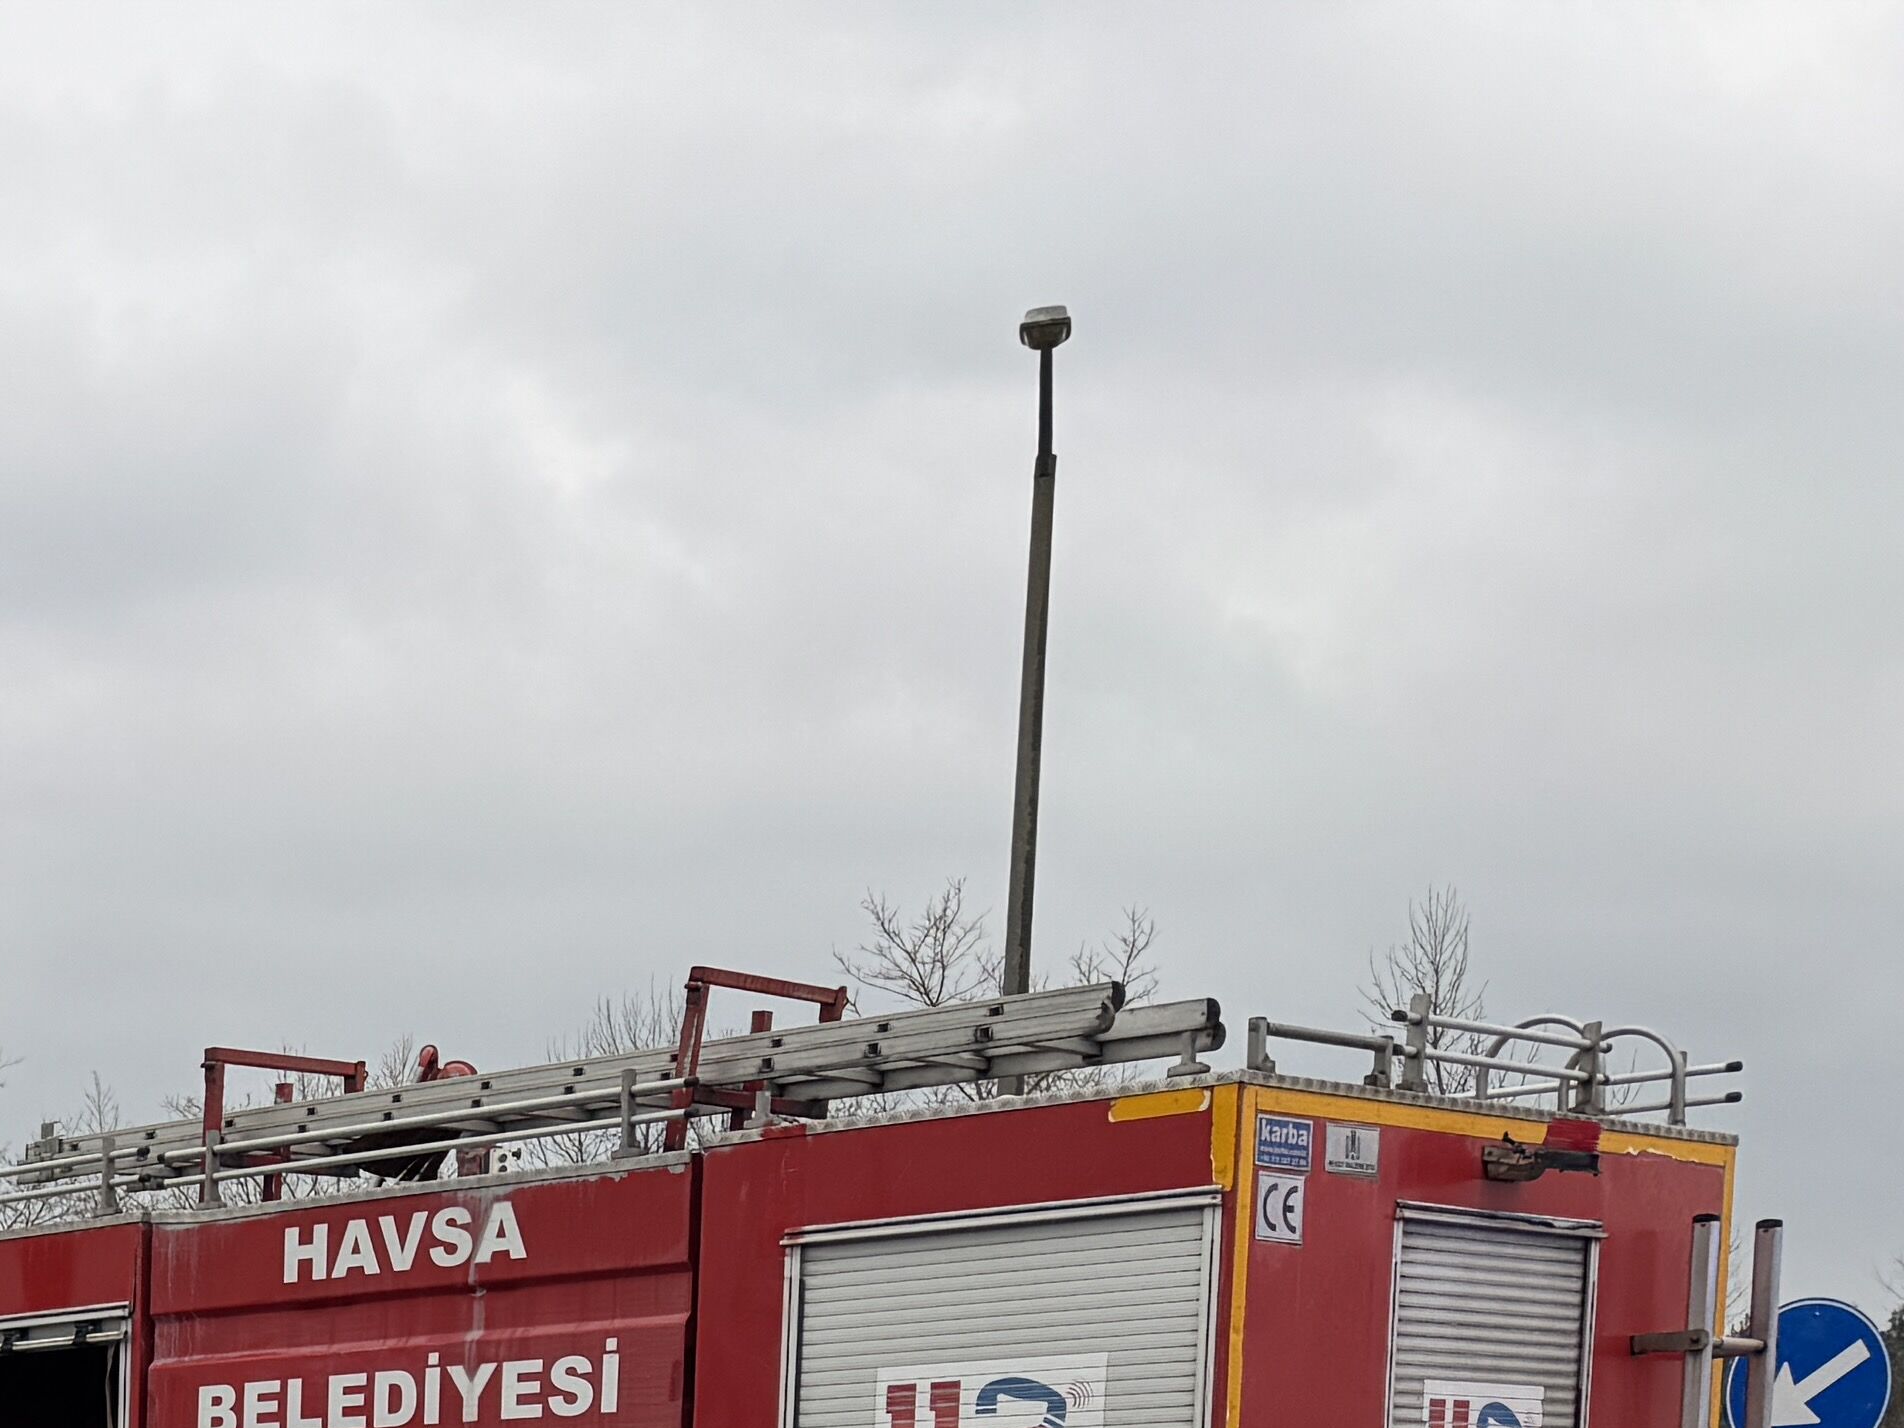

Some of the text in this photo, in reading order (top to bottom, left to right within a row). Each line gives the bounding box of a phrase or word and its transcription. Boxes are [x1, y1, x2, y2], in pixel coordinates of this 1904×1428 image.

[1261, 1119, 1308, 1146] karba
[1263, 1182, 1299, 1234] CE
[283, 1201, 528, 1284] HAVSA
